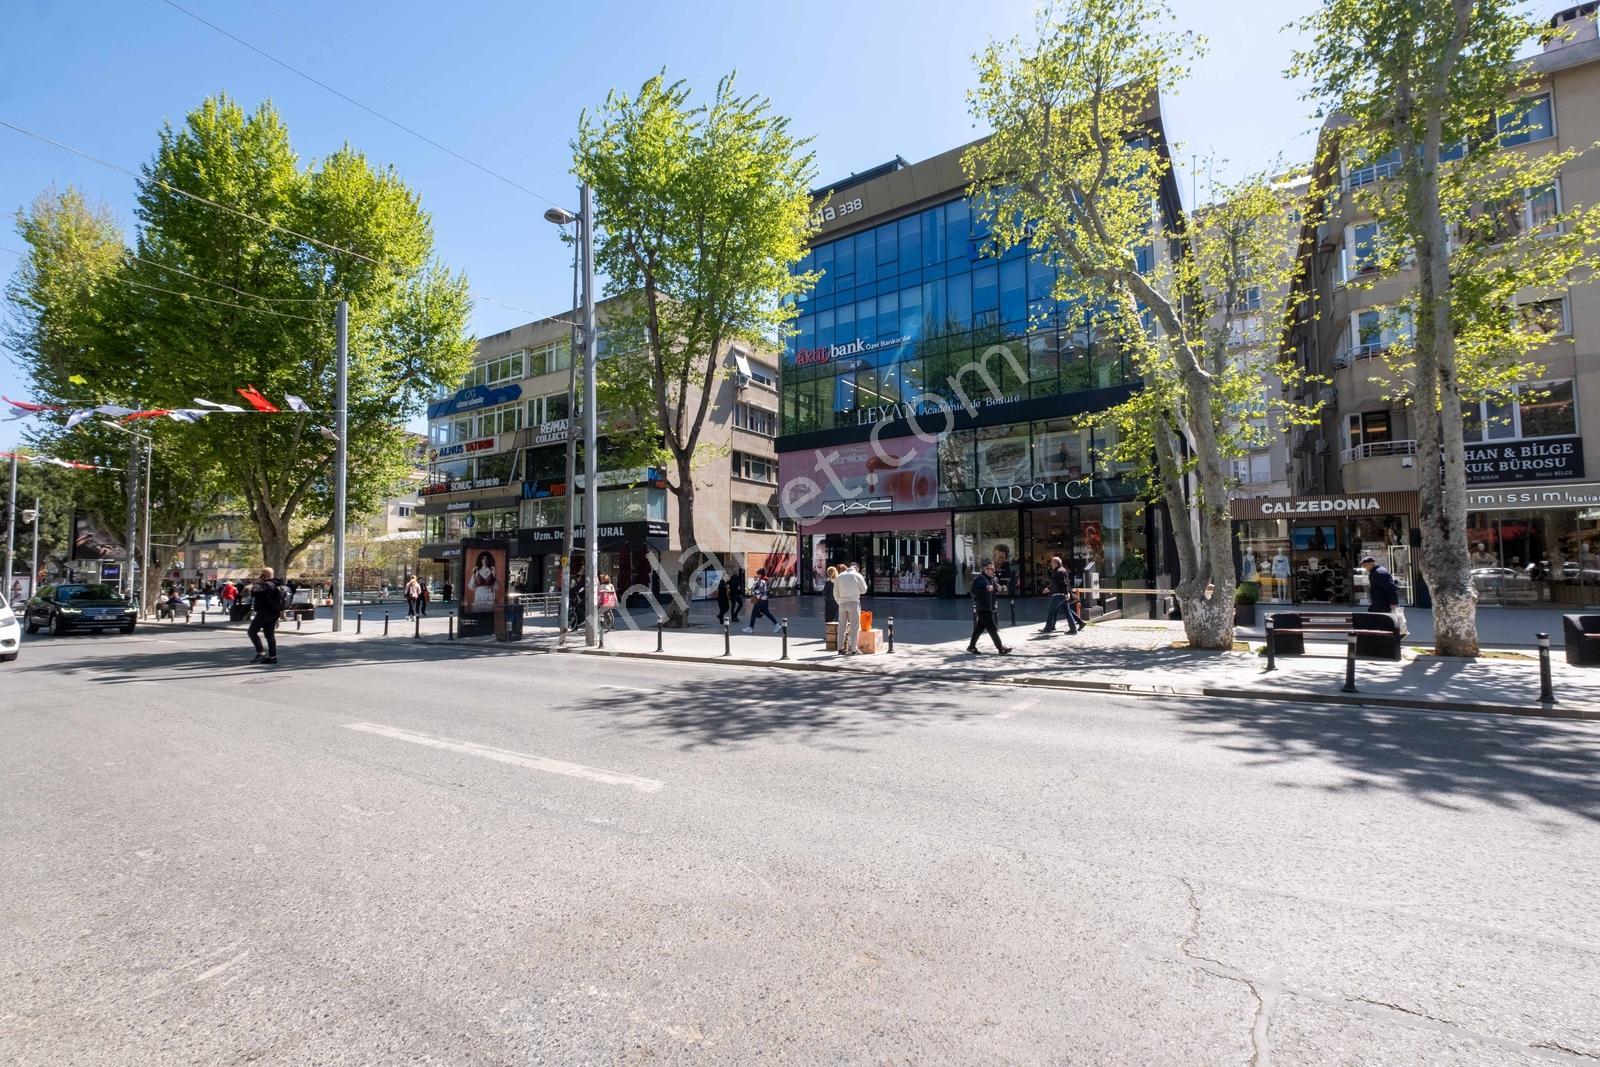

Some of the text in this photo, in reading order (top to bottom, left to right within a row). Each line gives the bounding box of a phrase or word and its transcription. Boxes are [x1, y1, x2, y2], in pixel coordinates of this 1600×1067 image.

[839, 198, 863, 216] 338
[439, 444, 464, 457] ALNUS
[1503, 447, 1516, 459] &
[1521, 443, 1574, 458] BİLGE
[1499, 457, 1567, 472] BÜROSU
[976, 480, 1094, 505] YARGICI
[1568, 495, 1600, 503] Italia
[1261, 498, 1380, 514] CALZEDONIA
[533, 530, 553, 541] Uzm.
